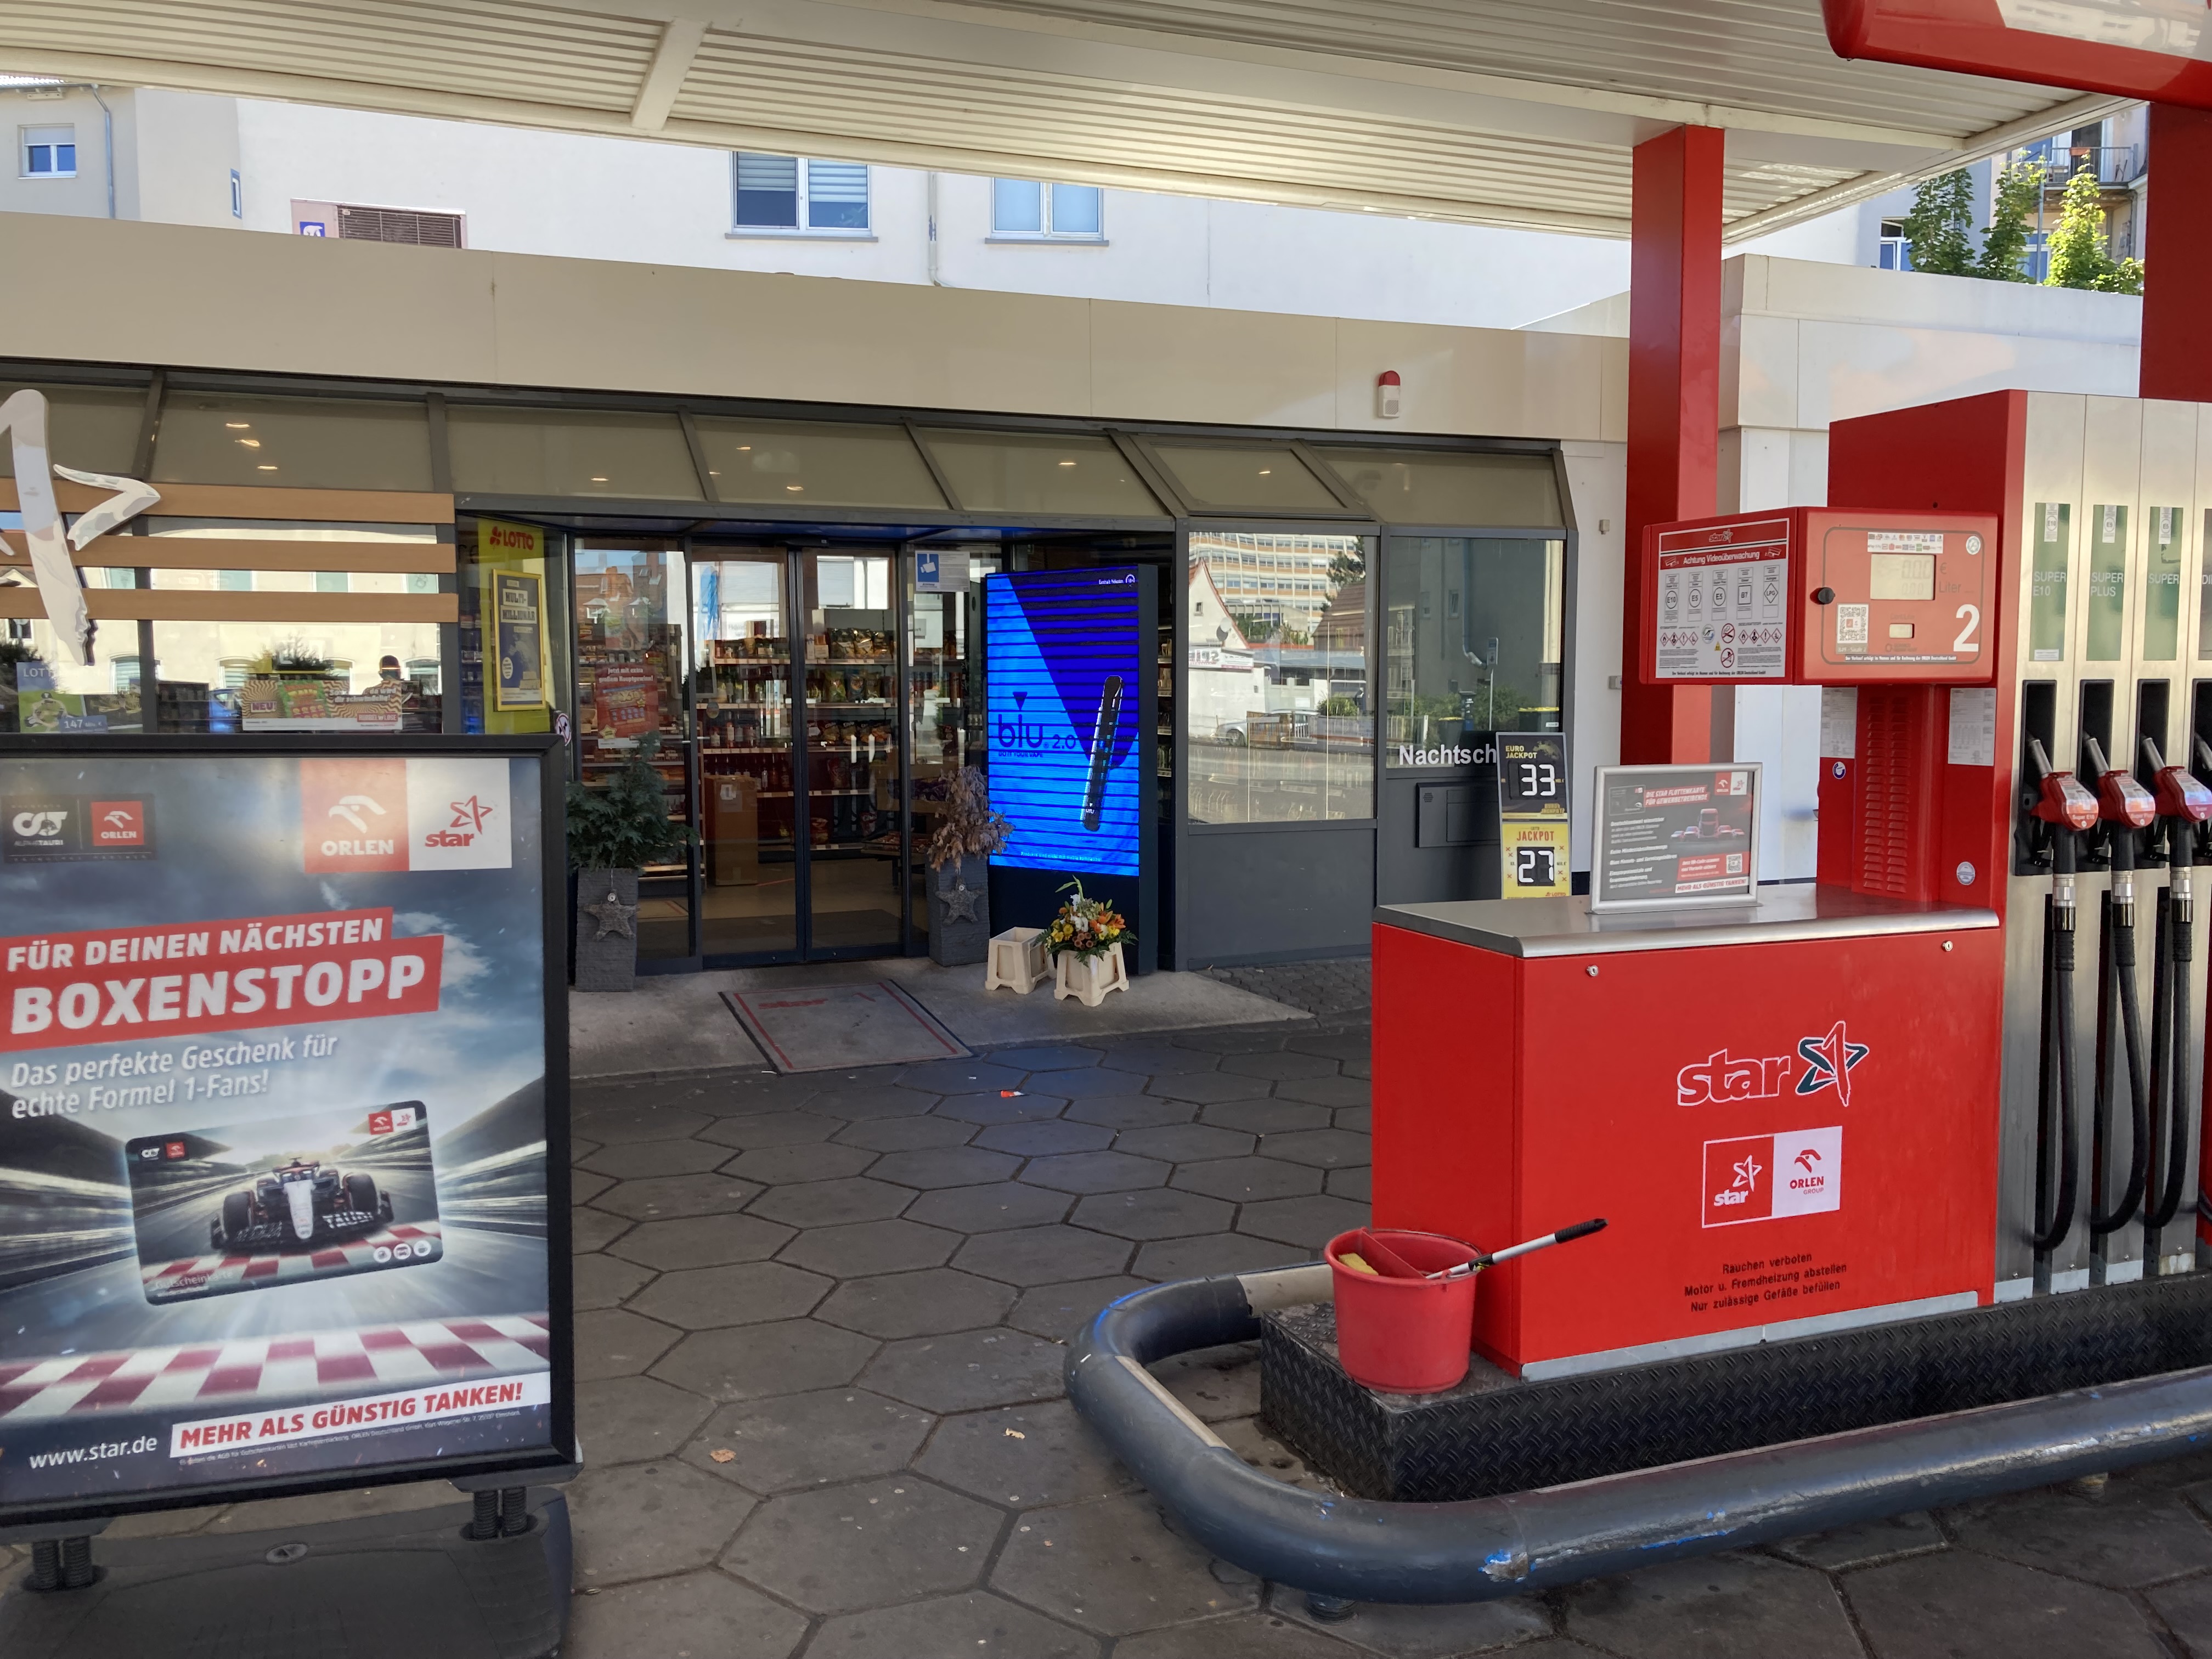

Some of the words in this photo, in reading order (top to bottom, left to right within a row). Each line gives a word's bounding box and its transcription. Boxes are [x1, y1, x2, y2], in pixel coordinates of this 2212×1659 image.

[504, 529, 534, 551] LOTTO
[1683, 556, 1705, 565] Achtung
[1707, 551, 1760, 562] Videoüberwachung
[1940, 562, 1947, 574] €
[2034, 571, 2066, 583] SUPER
[2091, 572, 2124, 583] SUPER
[1939, 581, 1961, 593] Liter
[2148, 573, 2179, 585] SUPER
[2033, 586, 2051, 596] E10
[2090, 586, 2116, 597] PLUS
[1953, 604, 1980, 652] 2
[64, 719, 83, 729] 147
[1052, 734, 1076, 749] 2.0
[1399, 743, 1497, 766] Nachtsch
[1520, 764, 1555, 795] 33
[101, 831, 137, 839] ORLEN
[425, 829, 476, 848] star
[1516, 831, 1554, 841] JACKPOT
[321, 839, 394, 857] ORLEN
[1518, 850, 1554, 883] 27
[8, 941, 74, 972] FÜR
[85, 932, 209, 966] DEINEN
[219, 917, 384, 955] NÄCHSTEN
[10, 954, 426, 1035] BOXENSTOPP
[11, 1061, 57, 1088] Das
[65, 1051, 173, 1086] perfekte
[182, 1037, 296, 1069] Geschenk
[302, 1033, 337, 1059] für
[1677, 1048, 1791, 1106] star
[12, 1093, 80, 1120] echte
[88, 1080, 176, 1113] Formel
[185, 1069, 269, 1101] 1-Fans!
[1790, 1176, 1824, 1189] ORLEN
[1803, 1187, 1824, 1195] GROUP
[1714, 1189, 1749, 1206] star
[1723, 1260, 1765, 1275] Rauchen
[1769, 1252, 1812, 1267] verboten
[1684, 1282, 1714, 1297] Motor
[1731, 1270, 1800, 1291] Fremdheizung
[1804, 1263, 1847, 1278] abstellen
[1691, 1300, 1708, 1312] Nur
[1713, 1293, 1759, 1310] zulässige
[1764, 1286, 1798, 1301] Gefäße
[1802, 1279, 1841, 1294] befüllen
[179, 1421, 251, 1449] MEHR
[258, 1413, 304, 1437] ALS
[312, 1398, 415, 1429] GÜNSTIG
[424, 1382, 524, 1413] TANKEN!
[240, 1444, 286, 1457] Gutscheinkarten
[371, 1426, 405, 1436] Deutschland
[29, 1435, 158, 1469] www.star.de
